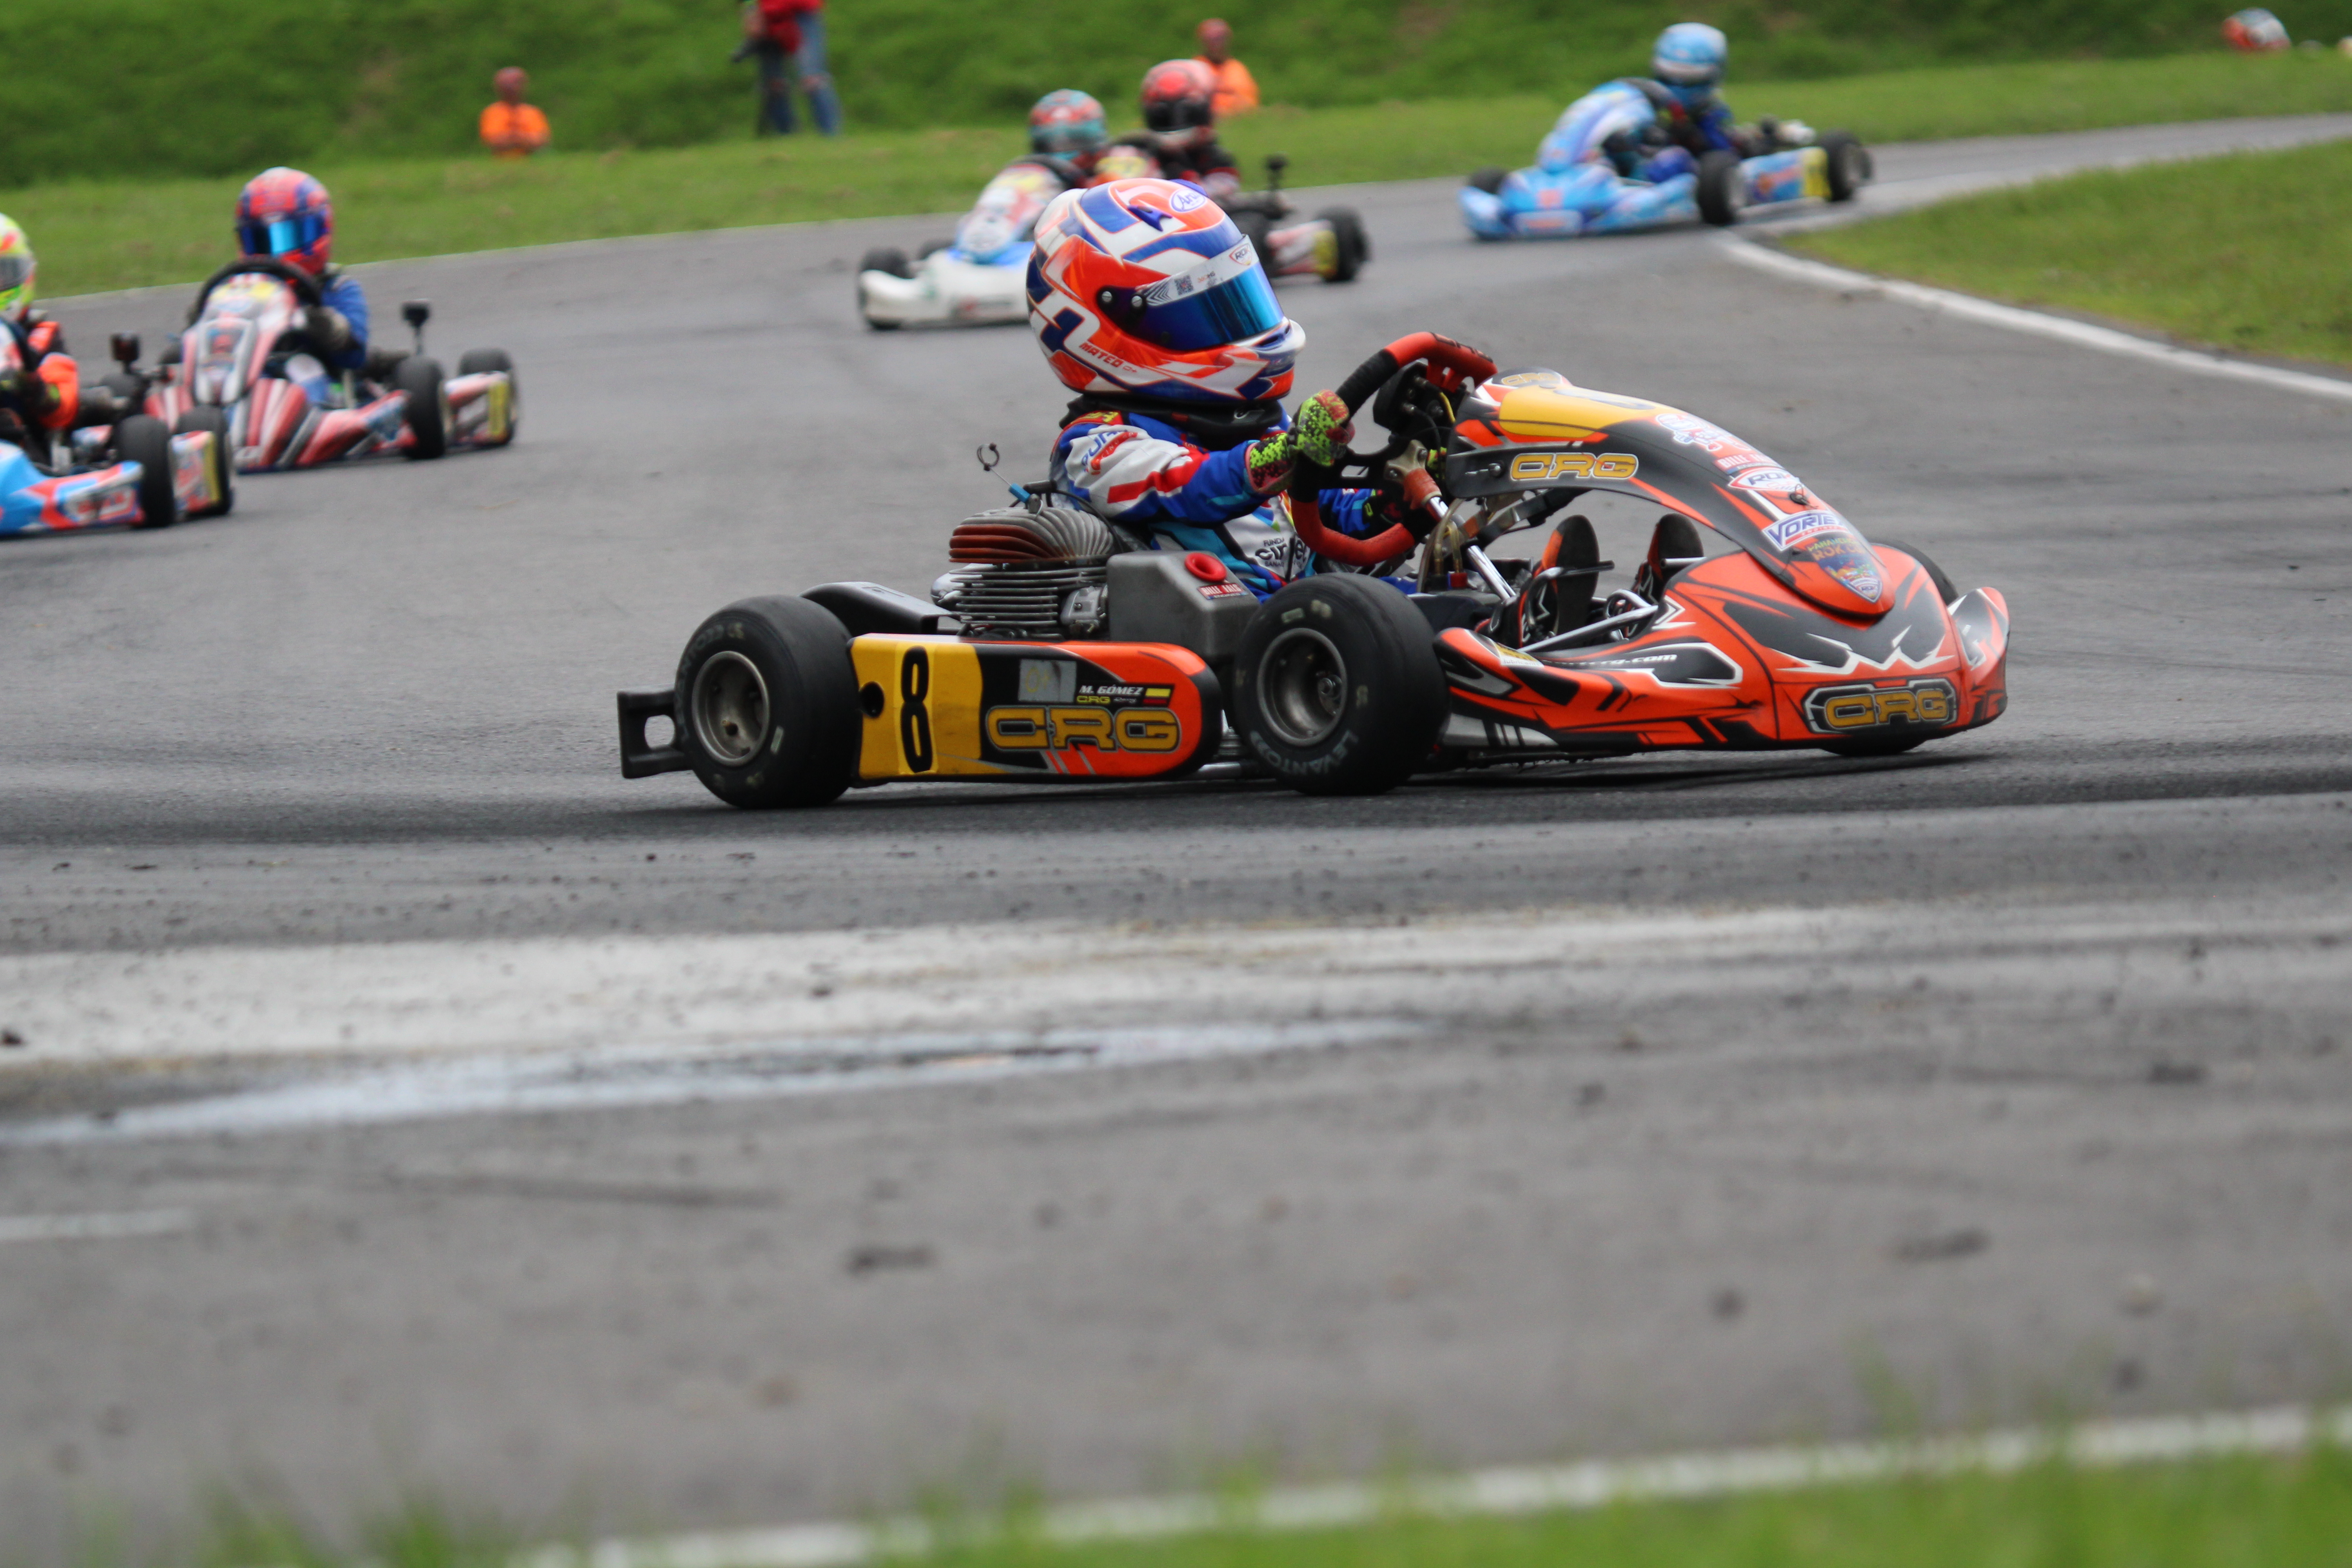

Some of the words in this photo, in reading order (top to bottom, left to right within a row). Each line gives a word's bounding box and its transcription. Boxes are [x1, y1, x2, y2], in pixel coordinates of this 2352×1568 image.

[1079, 342, 1124, 367] MATEO
[1510, 452, 1639, 481] CRG
[1076, 695, 1111, 704] CRG
[1079, 685, 1094, 693] M.
[1096, 684, 1144, 695] GÓMEZ
[900, 646, 933, 773] 8
[1824, 688, 1949, 730] CRG
[985, 706, 1181, 753] CRG
